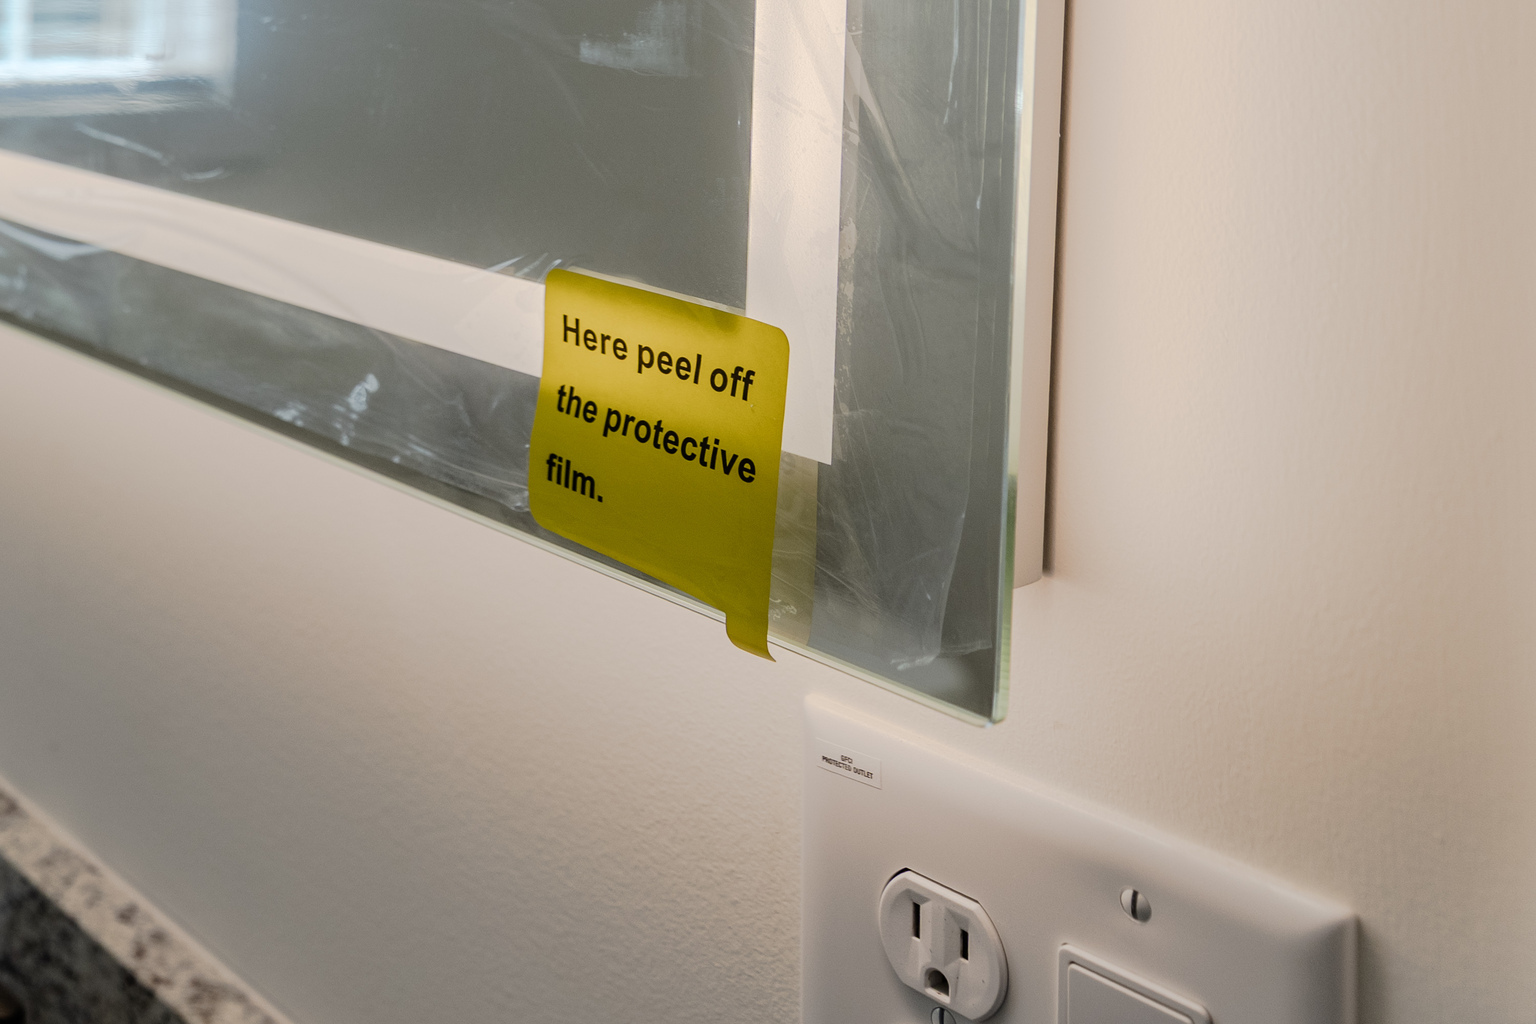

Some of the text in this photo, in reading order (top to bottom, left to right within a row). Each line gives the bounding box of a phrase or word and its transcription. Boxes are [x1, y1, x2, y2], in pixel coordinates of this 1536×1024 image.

[562, 314, 756, 402] Here peel off
[556, 384, 757, 483] the protective
[545, 453, 604, 503] film.
[822, 756, 873, 779] PROTECTED OUTLET
